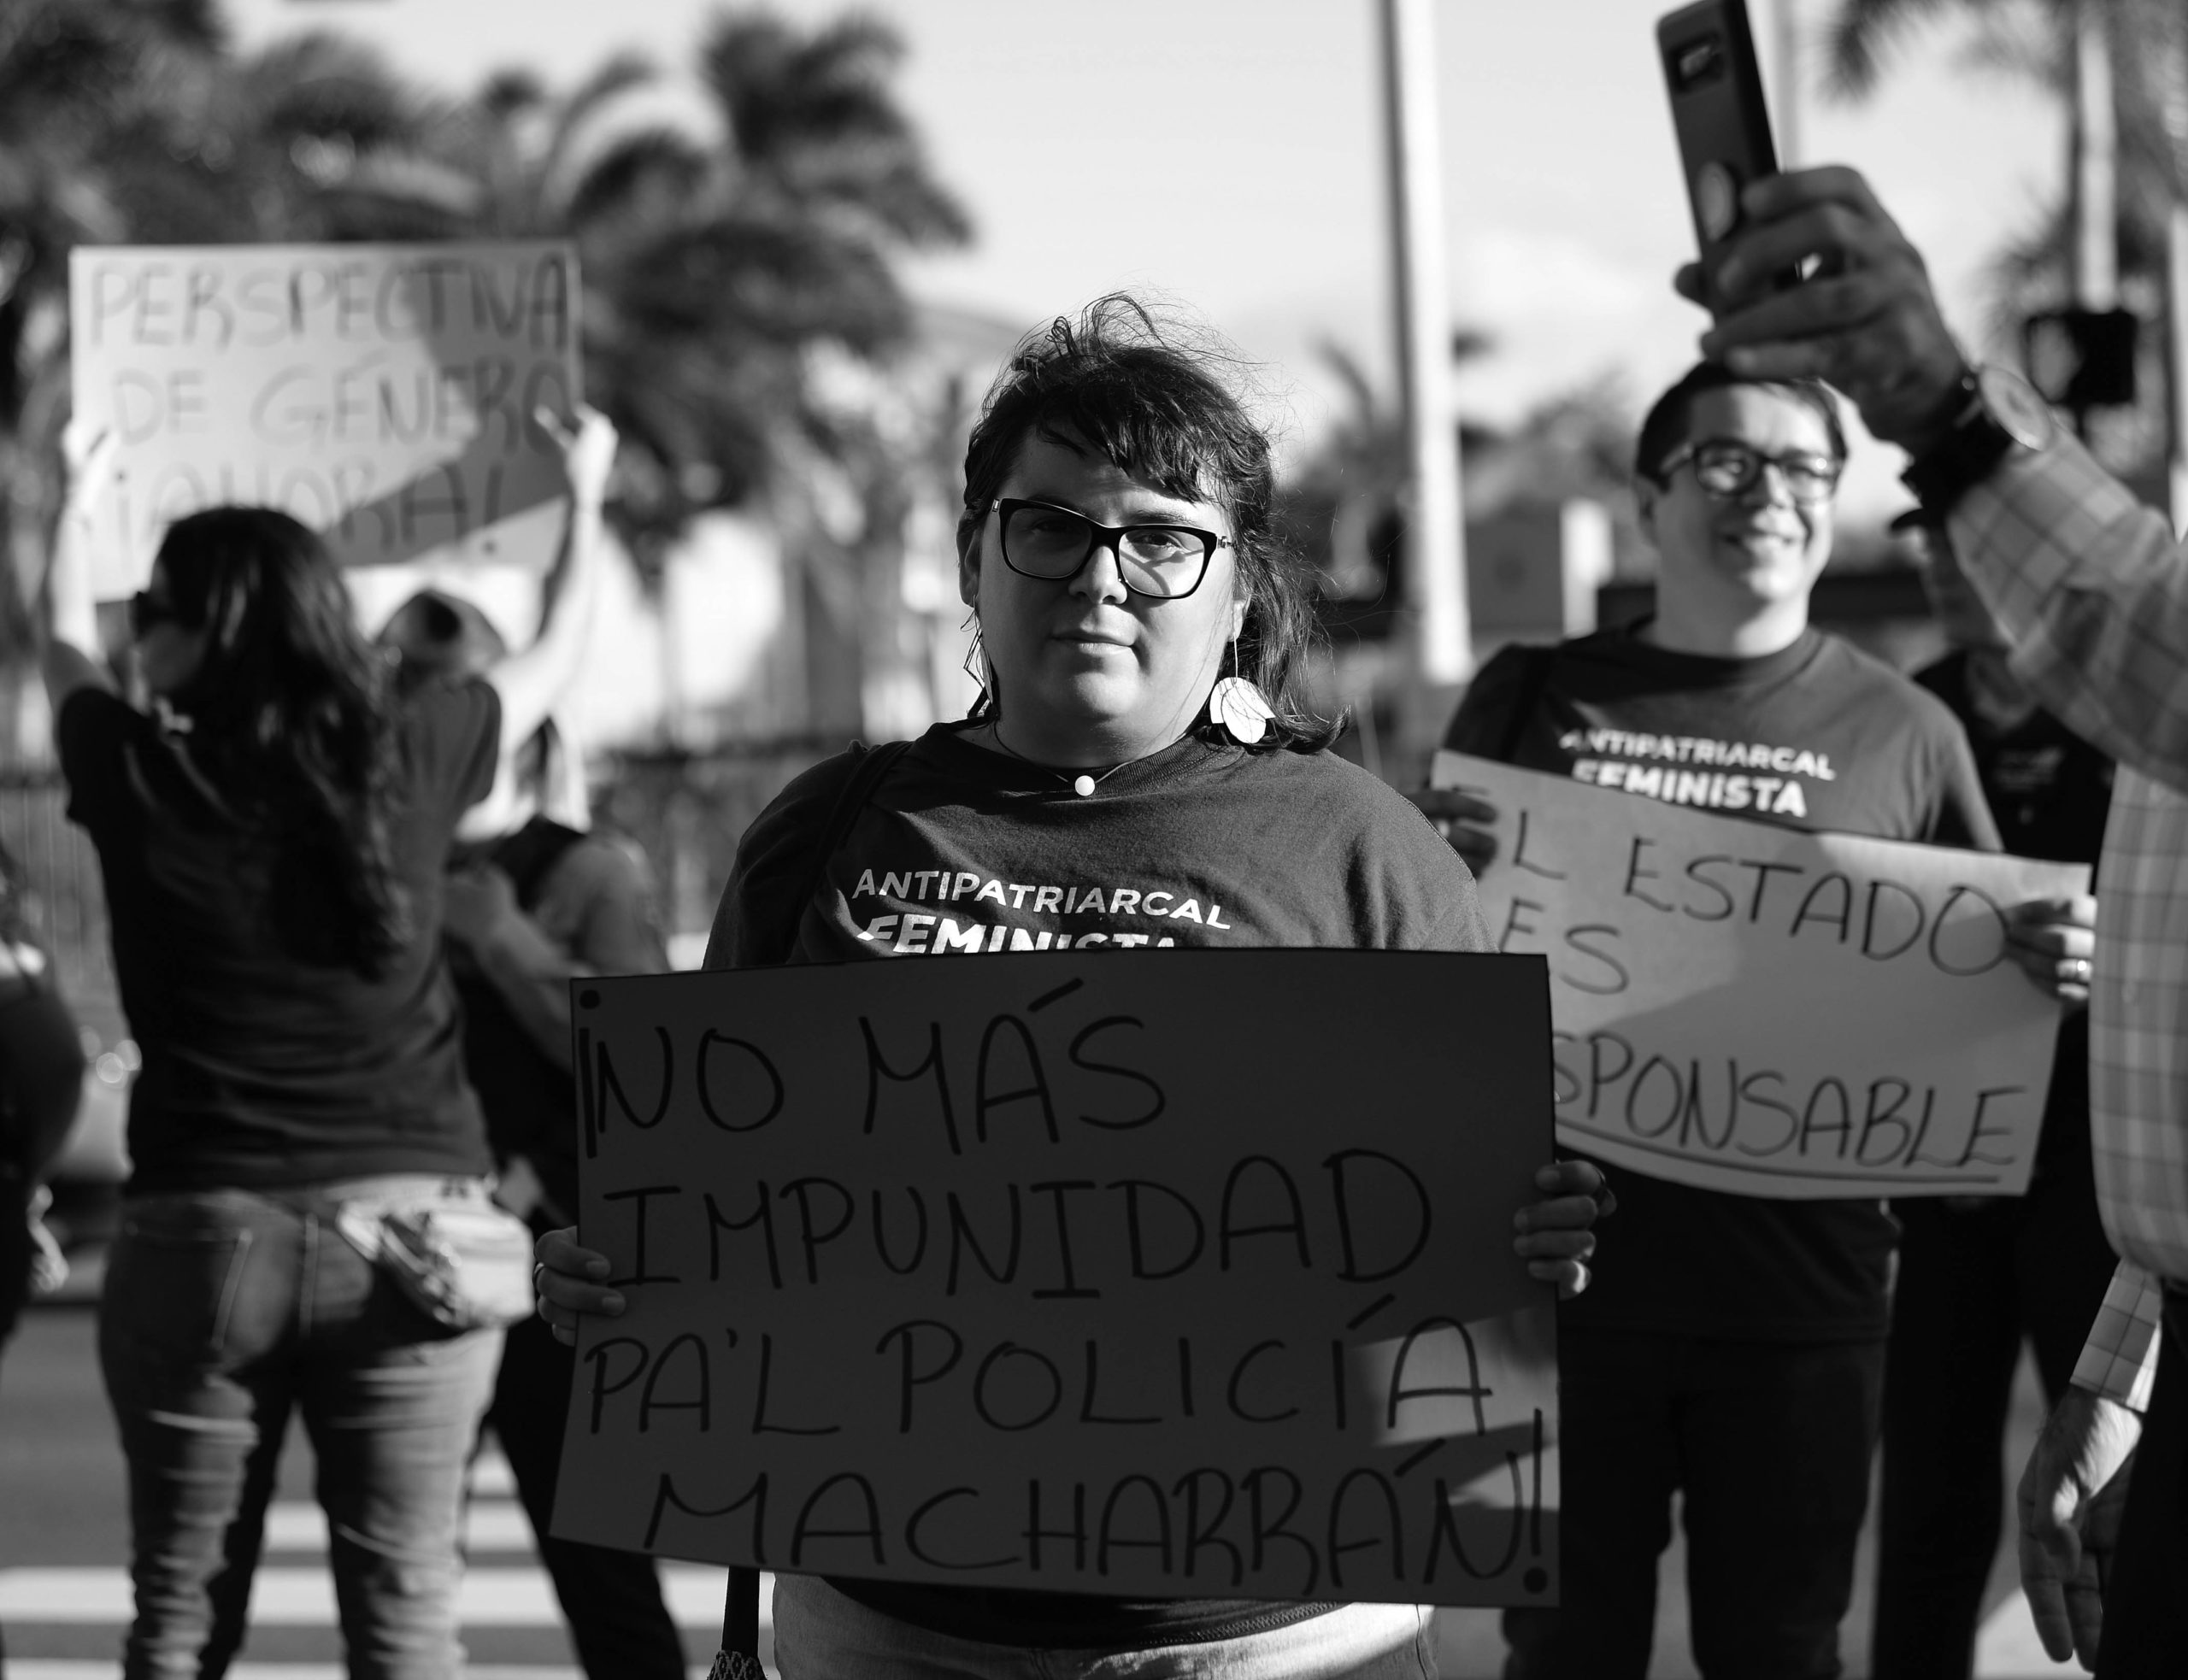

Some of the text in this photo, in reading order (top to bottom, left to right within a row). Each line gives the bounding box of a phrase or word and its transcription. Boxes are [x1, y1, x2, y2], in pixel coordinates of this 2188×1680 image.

[89, 251, 569, 352] PERSPECTIVA
[112, 366, 205, 447] DE
[1559, 727, 1836, 782] ANTIPATRIARCAL
[1573, 758, 1808, 819] FEMINISTA
[852, 868, 1232, 931] ANTIPATRIARCAL
[1623, 836, 2010, 977] ESTADO
[579, 977, 1166, 1159] ¡NO MÁS
[603, 1148, 1432, 1298] IMPUNIDAD
[584, 1293, 1494, 1436] PA'L POLICÍA
[643, 1407, 1549, 1597] MACHARRÁN!
